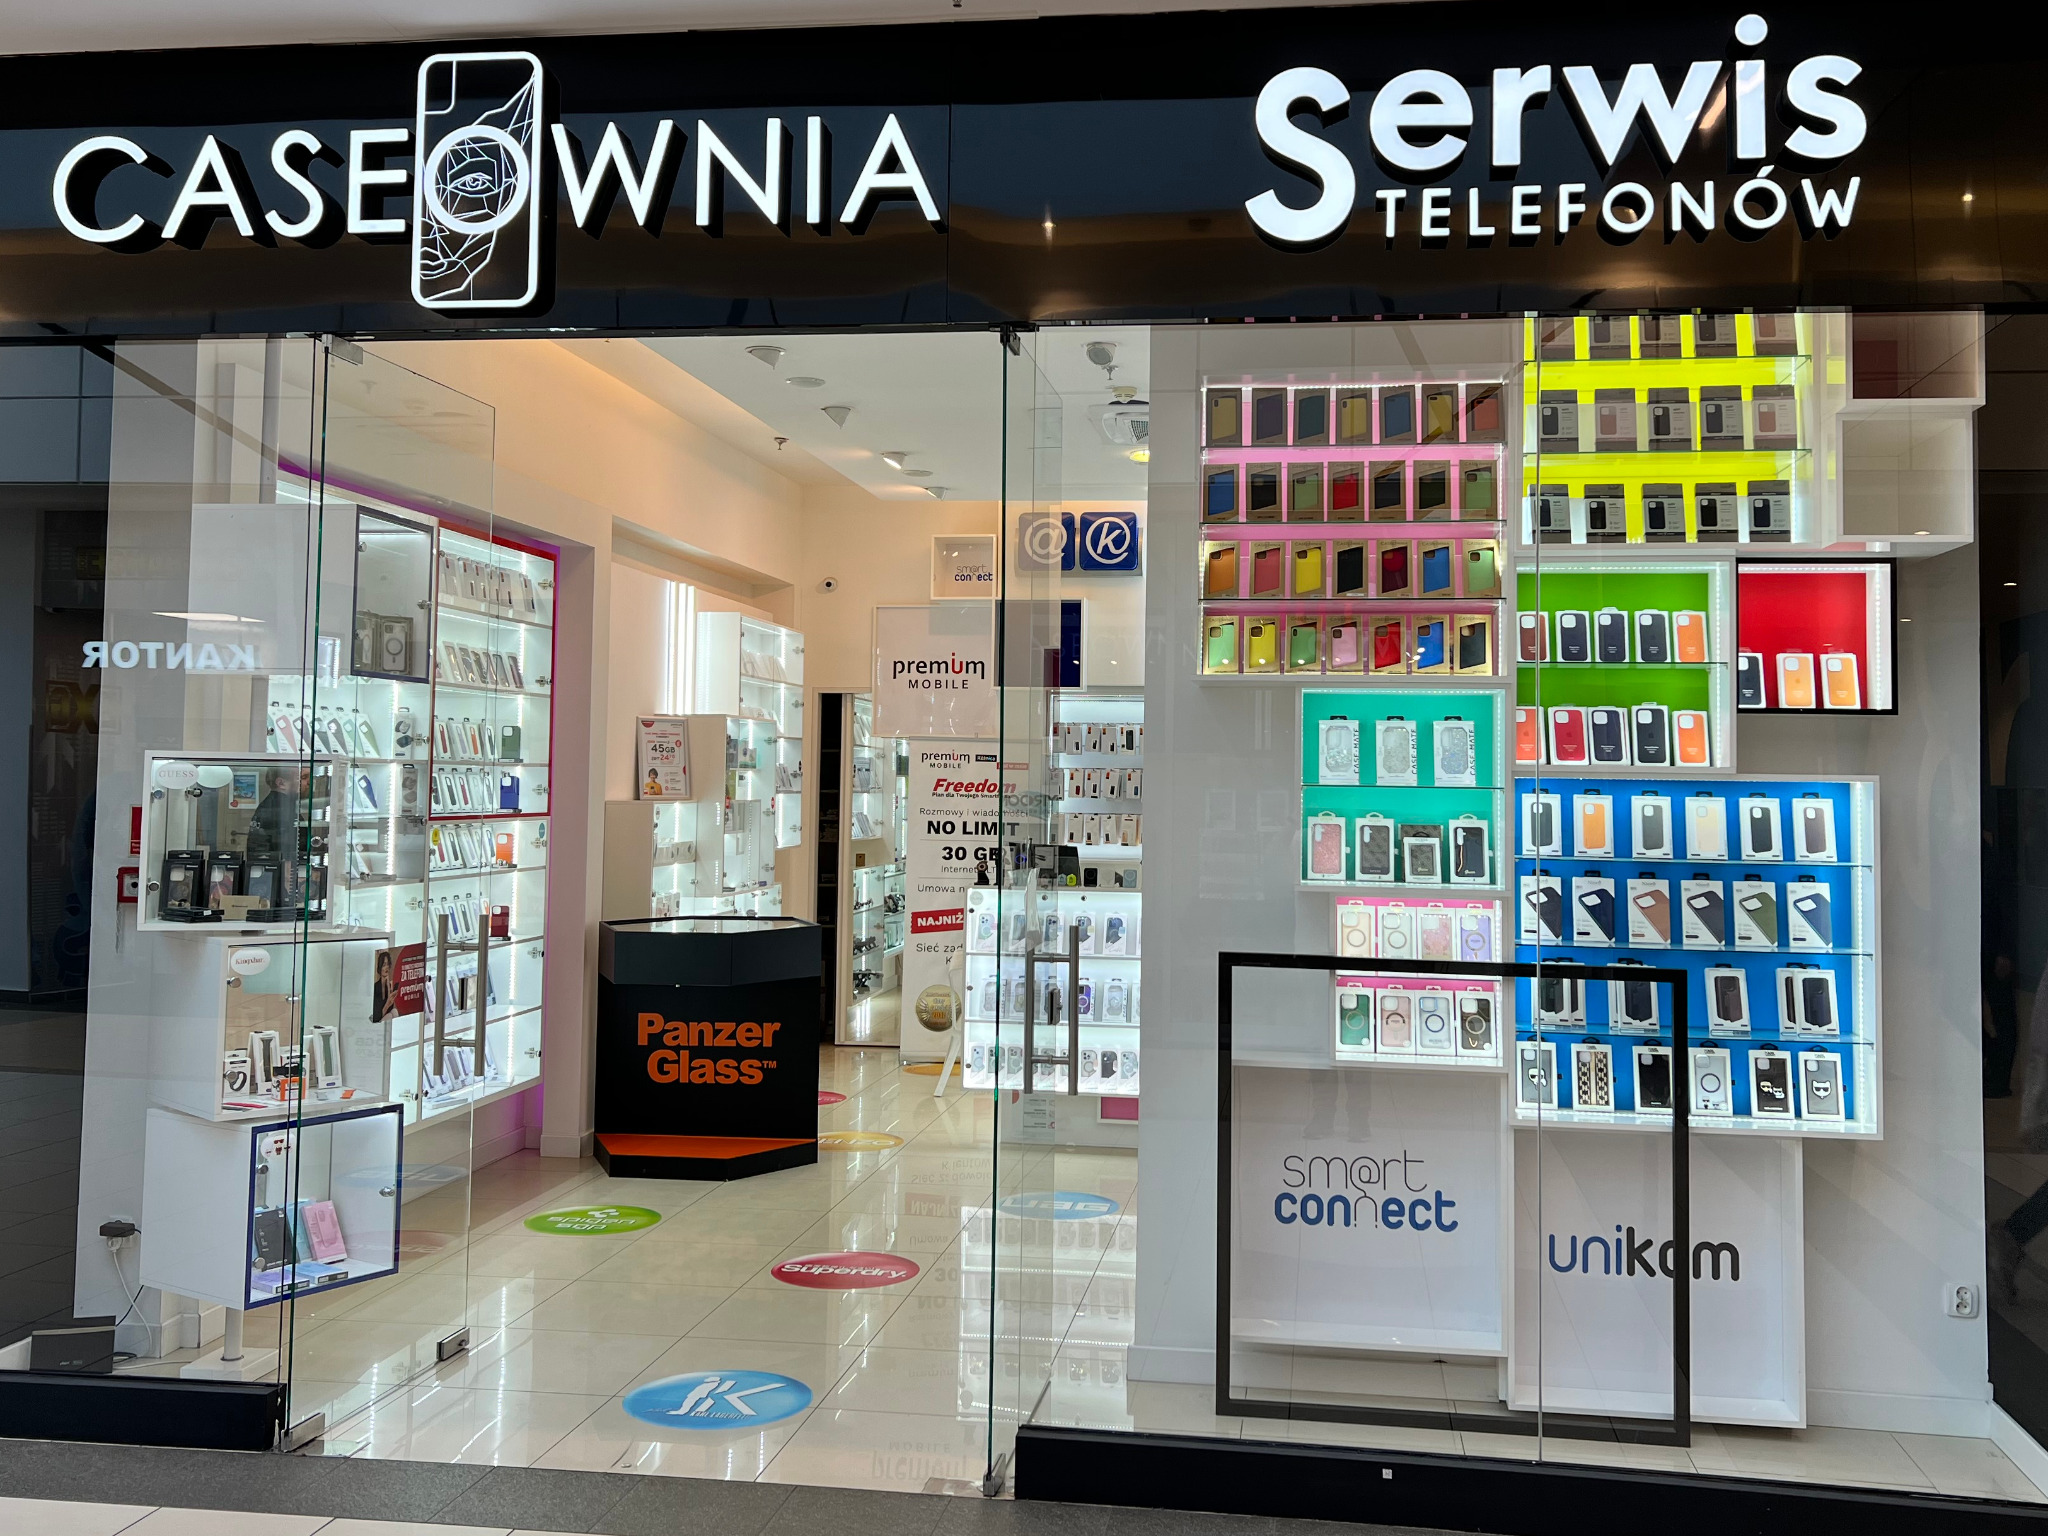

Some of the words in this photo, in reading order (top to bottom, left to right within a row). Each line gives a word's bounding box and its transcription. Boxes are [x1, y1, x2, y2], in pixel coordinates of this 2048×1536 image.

[1245, 14, 1868, 243] Serwis
[52, 112, 942, 243] CASEOWNIA
[1376, 166, 1861, 238] TELEFONÓW
[954, 572, 993, 582] connect
[892, 652, 985, 680] premium
[908, 679, 969, 689] MOBILE
[921, 749, 970, 764] premium
[158, 770, 195, 778] GUESS
[933, 778, 1017, 793] Freedom
[919, 807, 964, 818] Rozmowy
[927, 820, 956, 835] NO
[941, 846, 967, 861] 30
[917, 884, 956, 893] Umowa
[916, 942, 939, 953] Sieć
[637, 1012, 782, 1048] Panzer
[1273, 1189, 1460, 1234] connect
[546, 1215, 637, 1225] spigen
